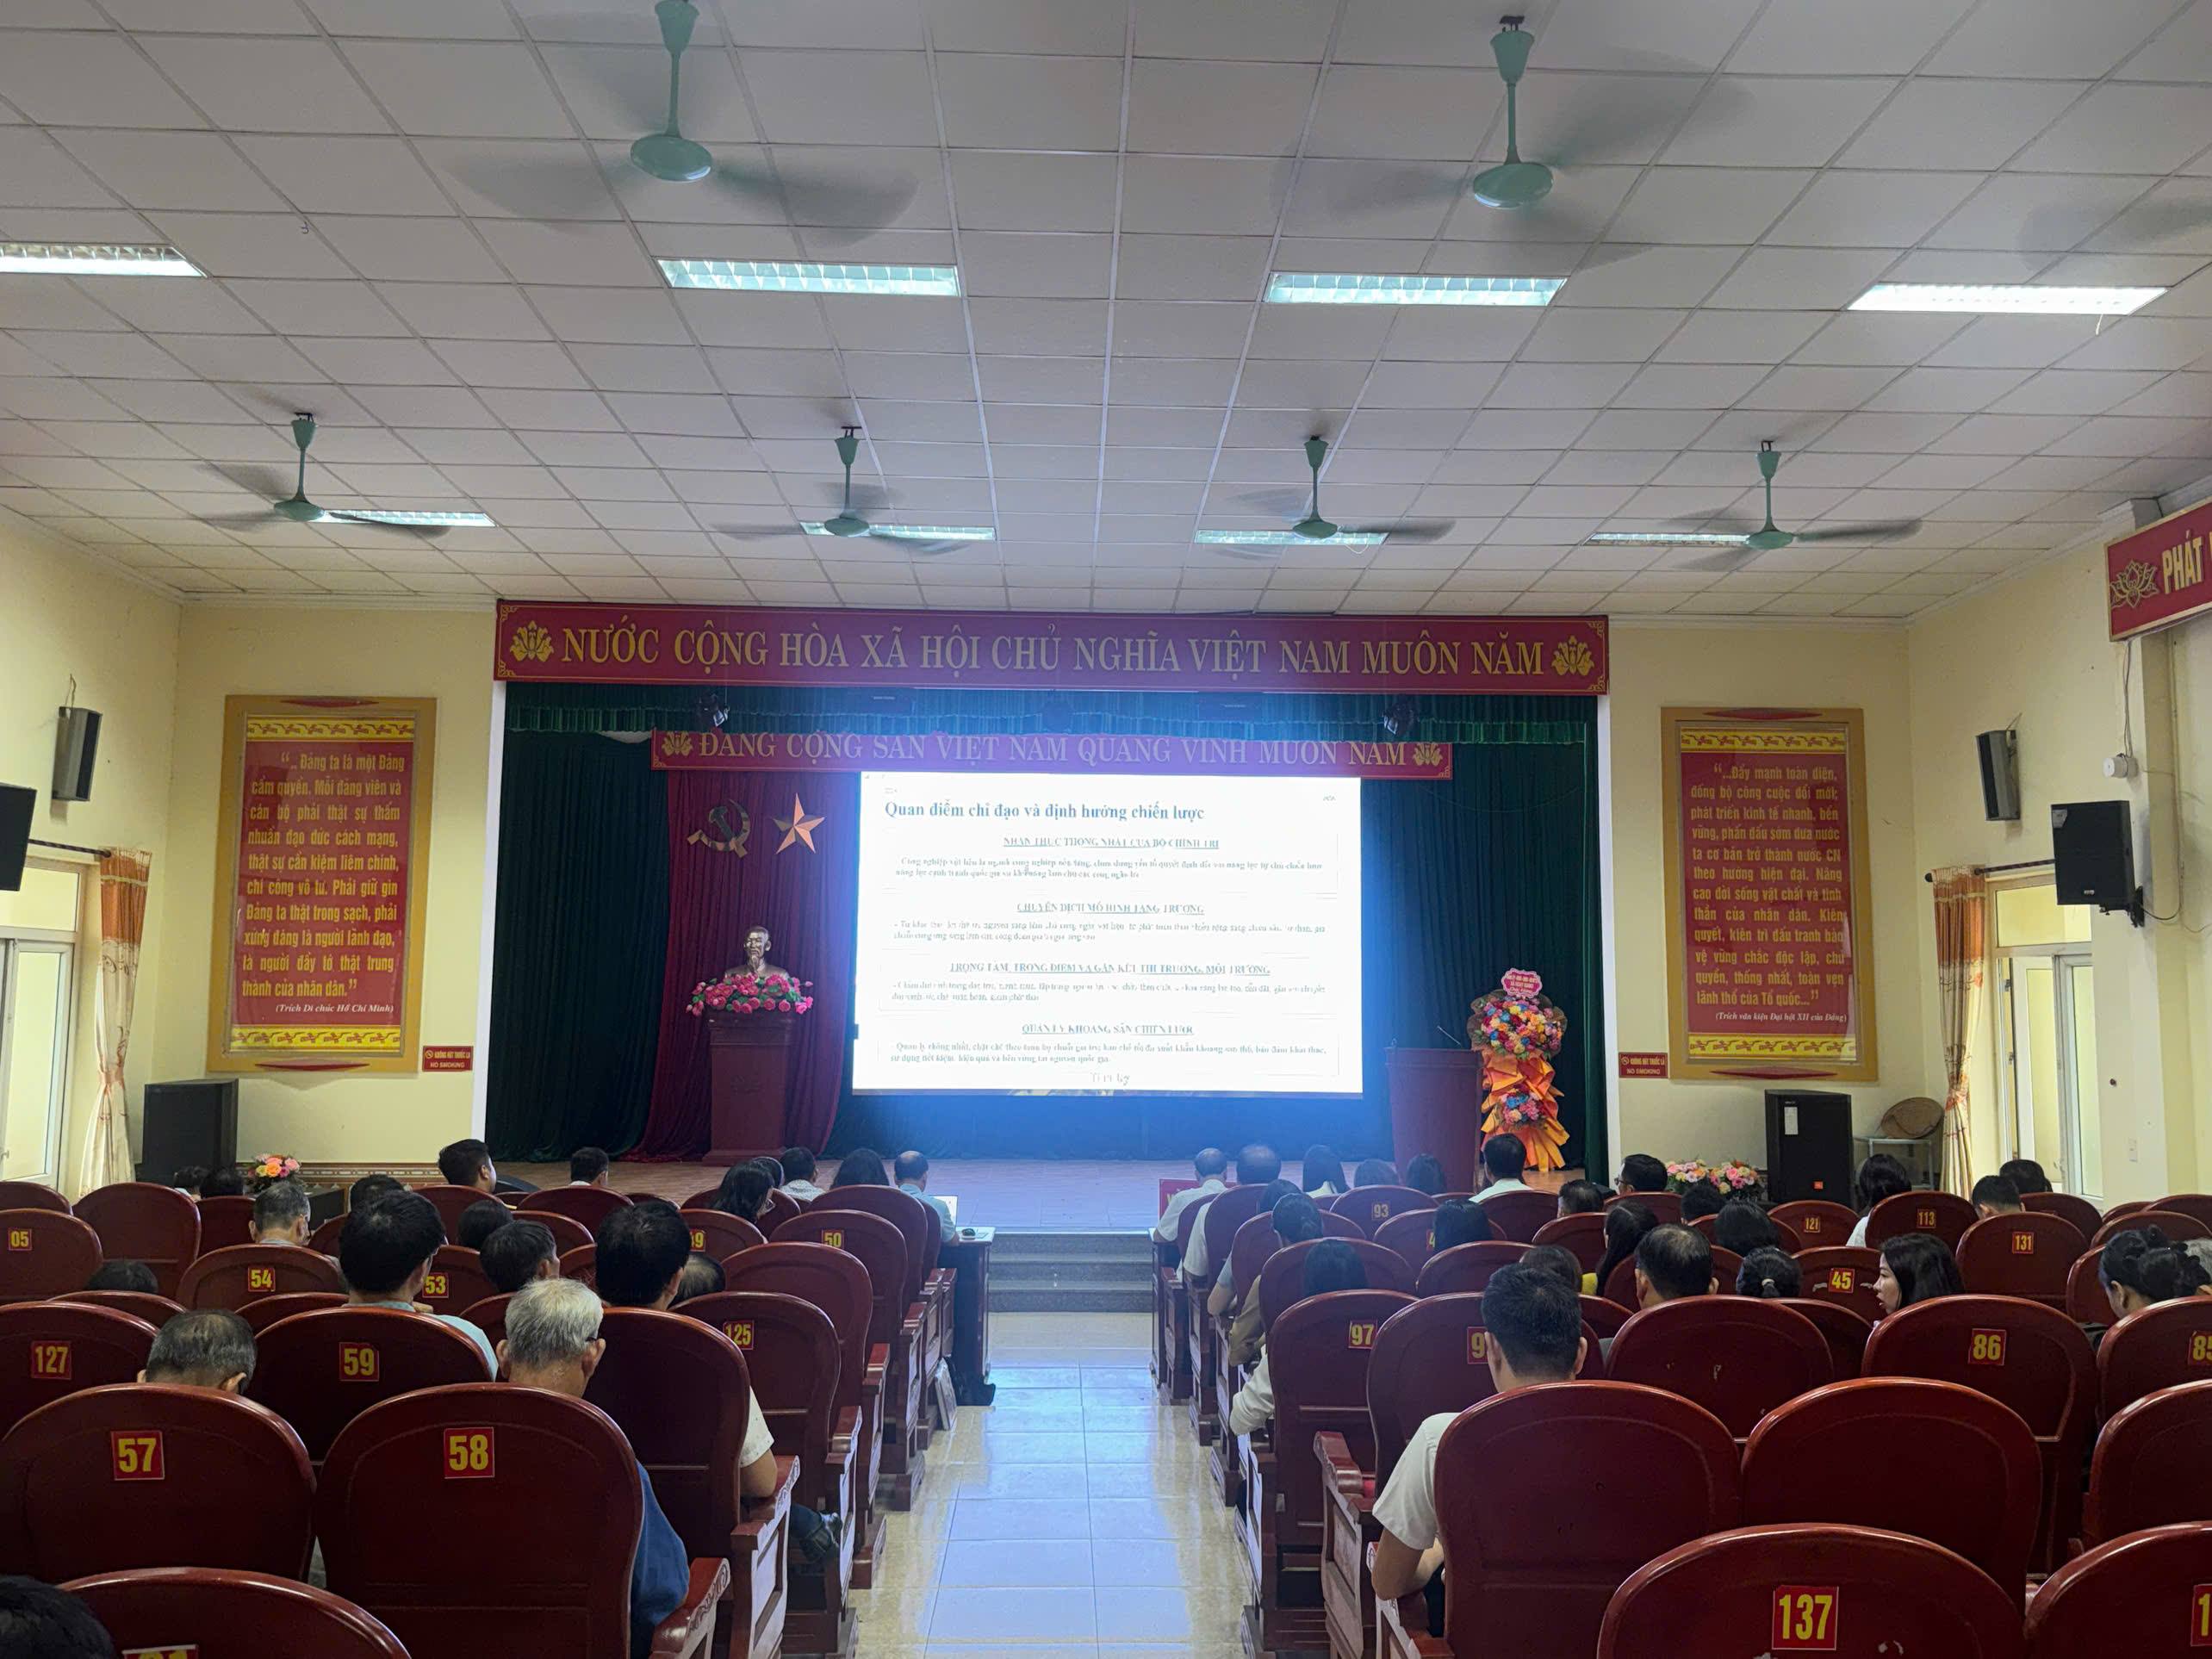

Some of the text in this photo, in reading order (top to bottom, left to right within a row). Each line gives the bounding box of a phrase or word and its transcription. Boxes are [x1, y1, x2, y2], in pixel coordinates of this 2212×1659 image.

[2162, 530, 2203, 594] PHÁT
[562, 615, 1544, 680] NƯỚC CỘNG HÒA XÃ HỘI CHỦ NGHĨA VIỆT NAM MUÔN NĂM
[1009, 736, 1069, 761] NAM
[1078, 737, 1171, 767] QUANG
[1180, 739, 1248, 764] VINH
[885, 802, 924, 818] Quan
[994, 803, 1019, 820] đạo
[1024, 805, 1041, 817] và
[1045, 803, 1077, 820] định
[1131, 801, 1169, 819] chiến
[1172, 805, 1205, 823] lược
[1373, 1204, 1389, 1218] 93
[1918, 1211, 1936, 1227] 113
[10, 1230, 29, 1247] 05
[823, 1232, 842, 1248] 50
[2015, 1234, 2032, 1251] 131
[251, 1269, 273, 1289] 54
[425, 1275, 446, 1295] 53
[1831, 1271, 1852, 1289] 45
[725, 1324, 752, 1345] 125
[1351, 1324, 1375, 1345] 97
[1973, 1333, 2002, 1361] 86
[34, 1345, 69, 1375] 127
[344, 1348, 375, 1376] 59
[117, 1437, 158, 1474] 57
[449, 1433, 489, 1471] 58
[1778, 1593, 1834, 1641] 137
